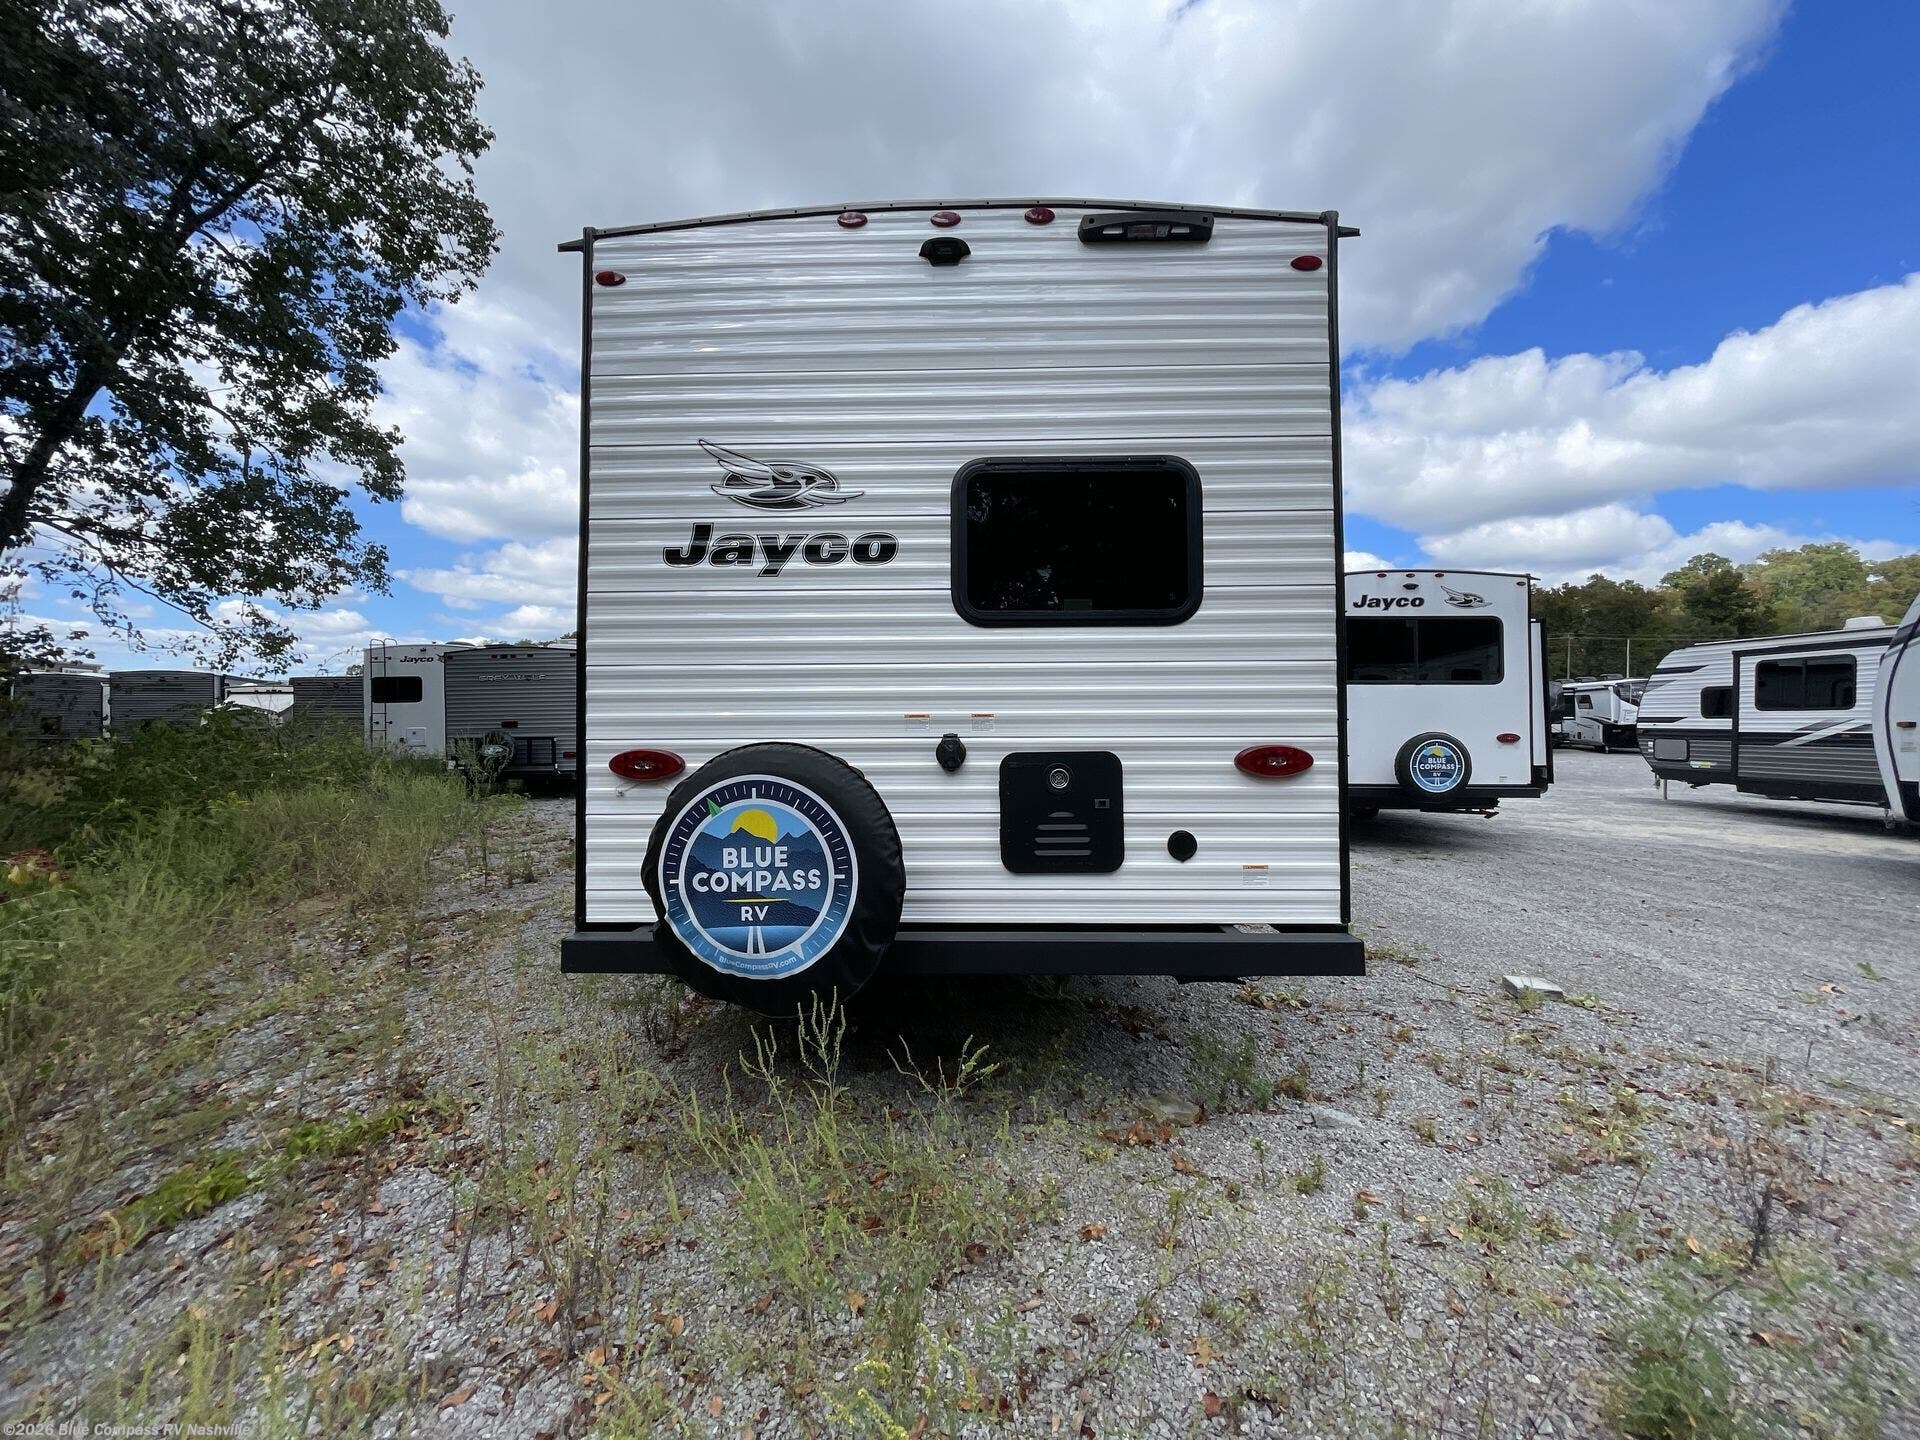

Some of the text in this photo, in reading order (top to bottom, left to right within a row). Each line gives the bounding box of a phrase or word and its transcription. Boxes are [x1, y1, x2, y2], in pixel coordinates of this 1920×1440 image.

[663, 522, 899, 577] Jayco
[1353, 594, 1425, 611] Jayco
[400, 655, 434, 664] Jayco
[722, 846, 788, 869] BLUE
[692, 869, 821, 893] COMPASS
[741, 905, 769, 922] RV
